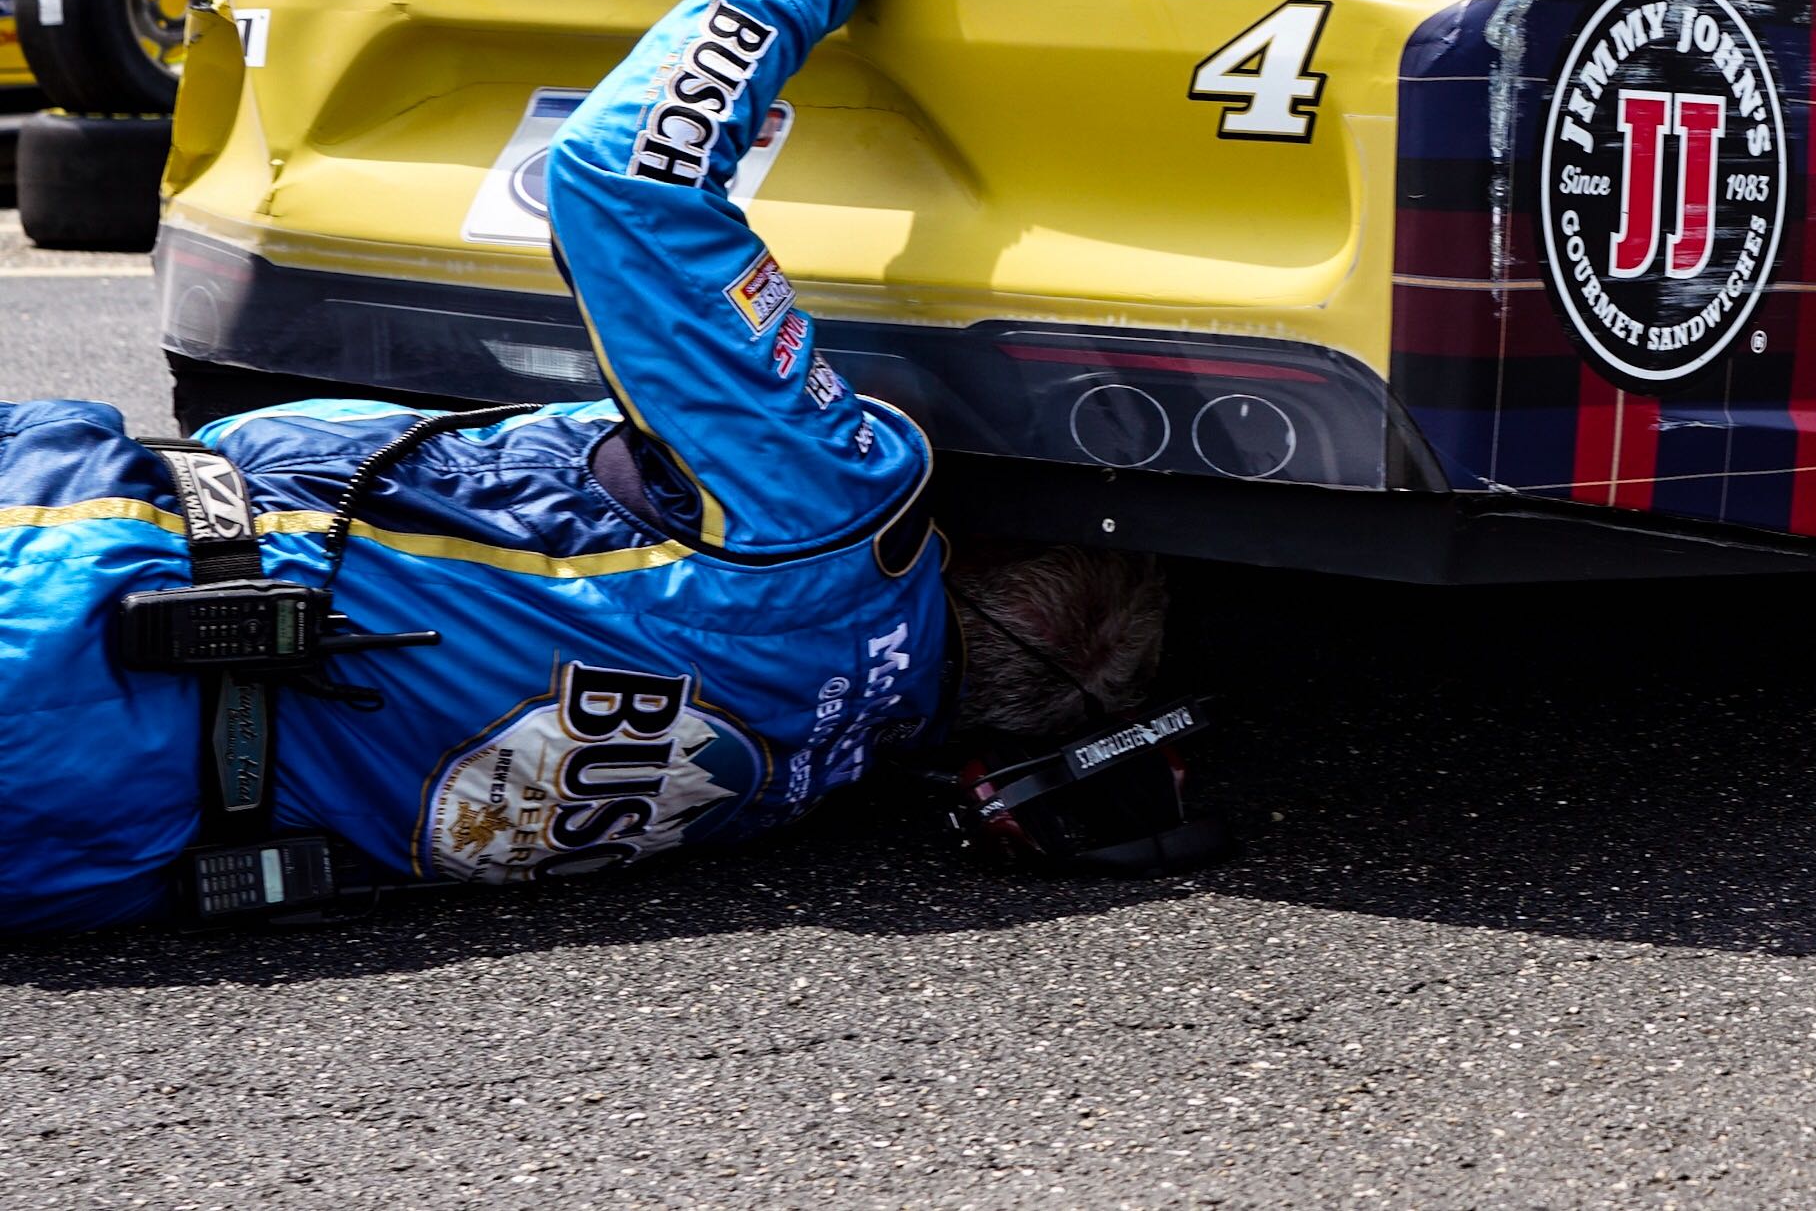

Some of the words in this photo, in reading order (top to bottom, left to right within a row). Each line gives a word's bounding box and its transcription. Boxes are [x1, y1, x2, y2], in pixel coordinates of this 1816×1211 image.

[1562, 1, 1670, 153] JIMMY
[1675, 5, 1773, 158] JOHN'S
[1559, 164, 1611, 196] Since
[1725, 173, 1771, 202] 1983
[1561, 209, 1644, 348] GOURMET
[1646, 214, 1766, 352] SANDWICHES
[184, 494, 220, 541] WEAR
[490, 748, 514, 805] BREWED
[536, 660, 692, 881] BUSC
[505, 784, 546, 866] BEER
